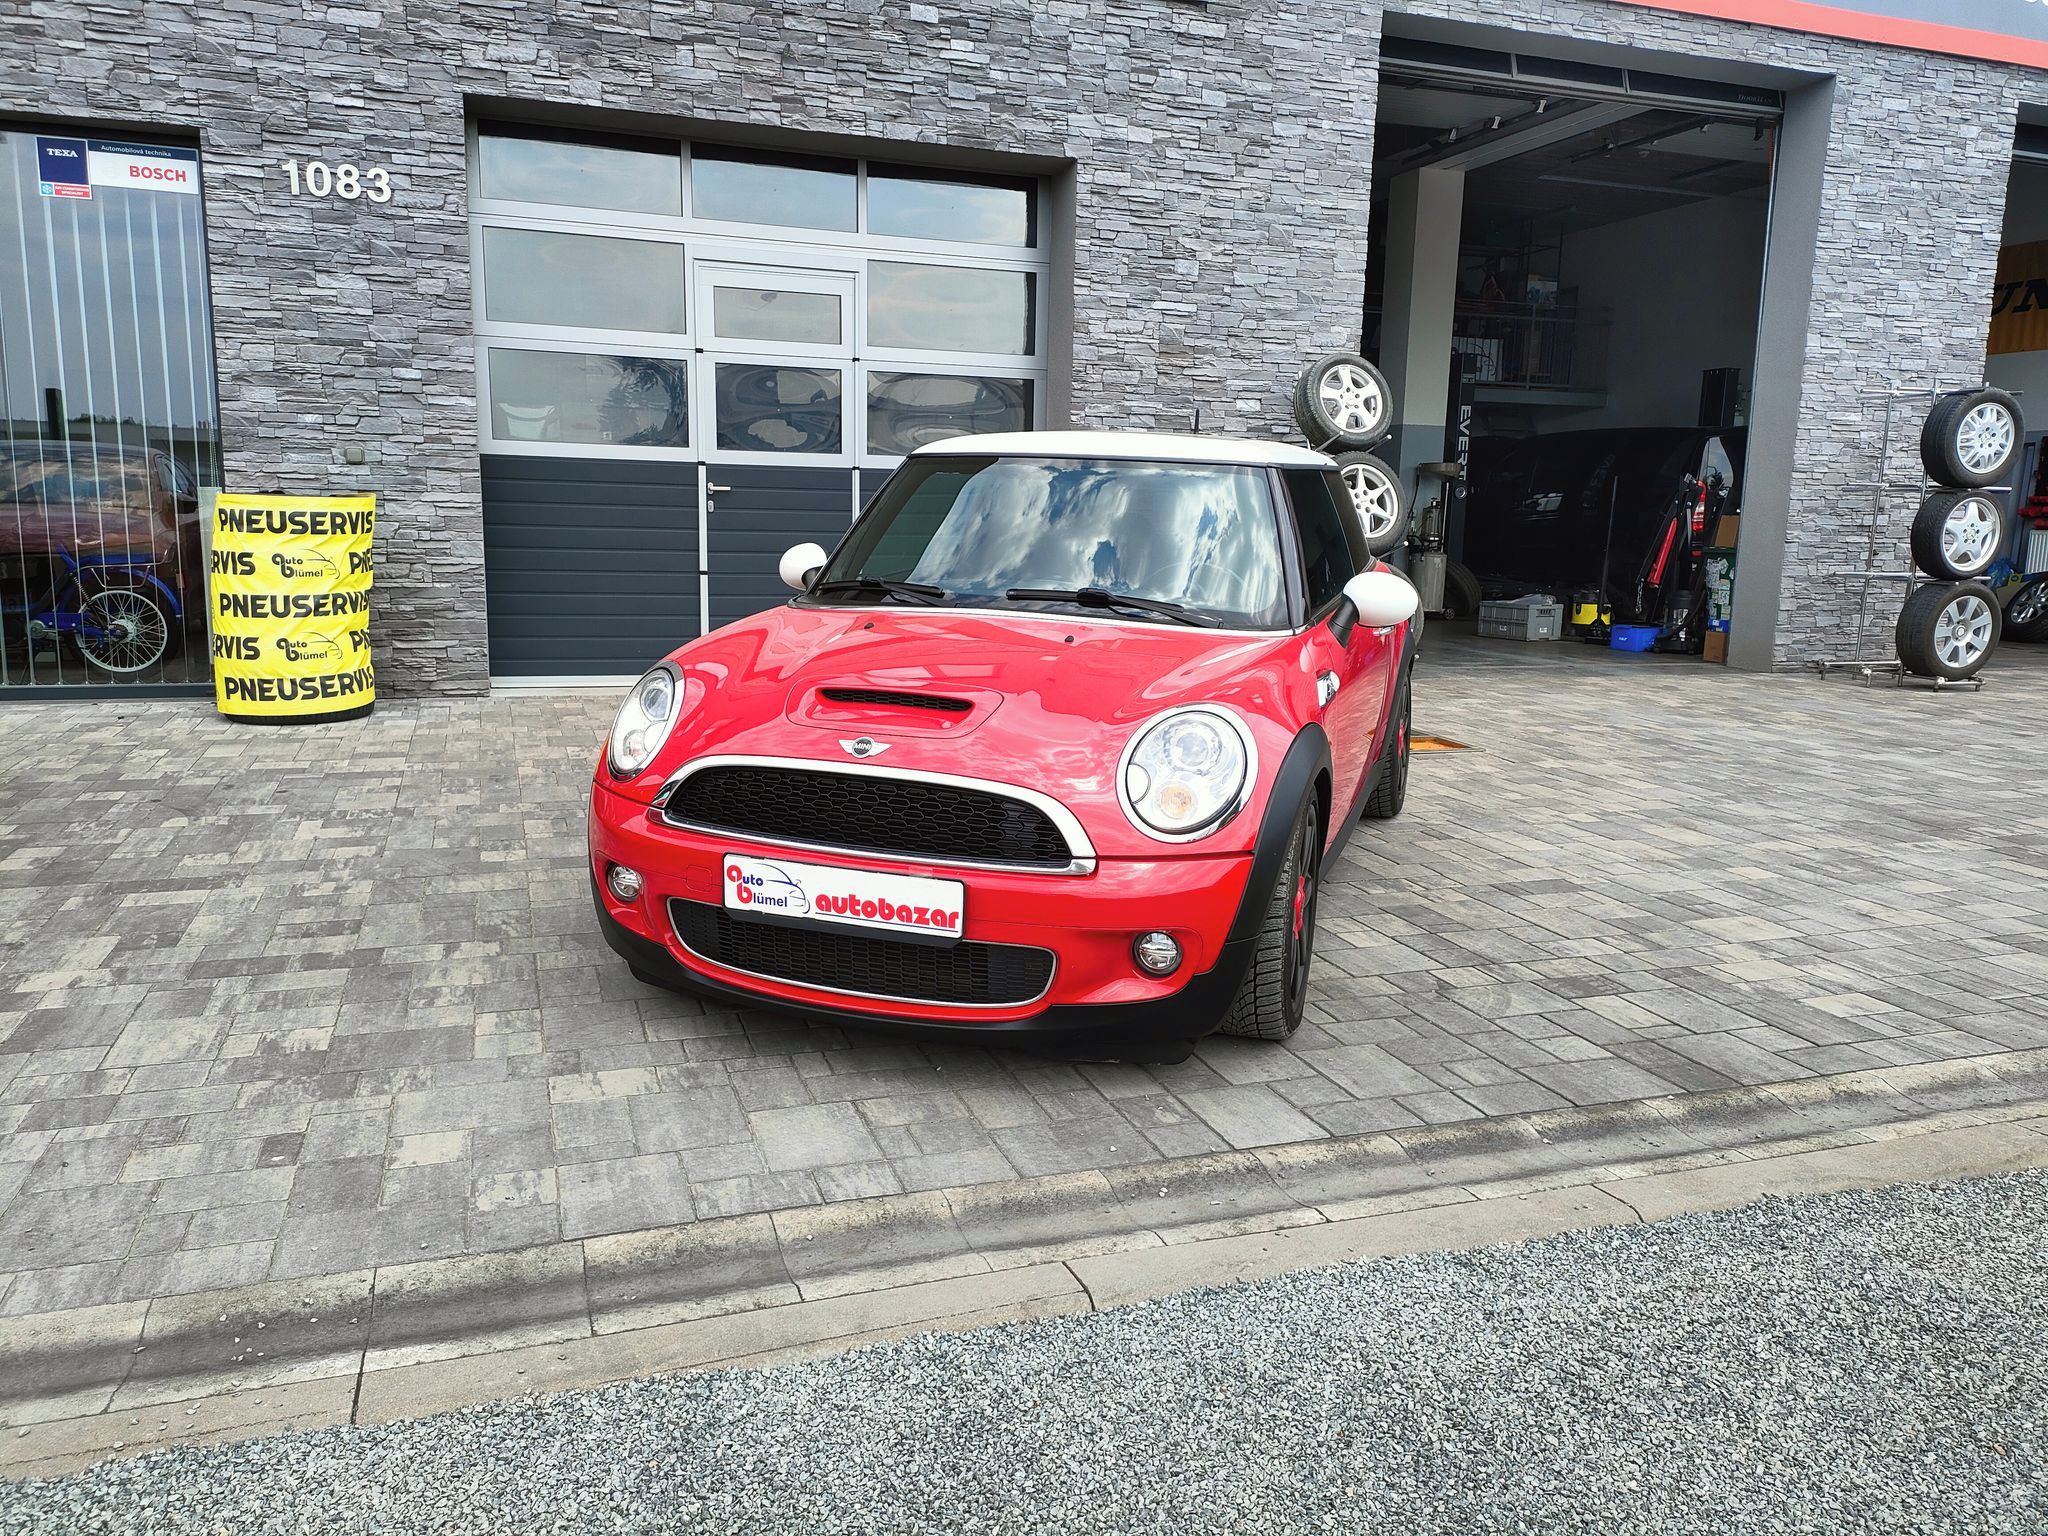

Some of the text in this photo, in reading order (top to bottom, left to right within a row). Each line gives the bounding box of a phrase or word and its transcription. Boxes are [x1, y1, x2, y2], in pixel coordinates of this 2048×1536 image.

[46, 148, 79, 158] TEXA
[101, 144, 172, 158] Automobilová technika
[129, 164, 187, 182] BOSCH
[281, 159, 392, 203] 1083
[1457, 405, 1472, 481] EVERT
[218, 508, 373, 536] PNEUSERVIS
[219, 589, 370, 619] PNEUSERVIS
[224, 665, 374, 702] PNEUSERVIS
[854, 743, 872, 751] MINI
[736, 881, 959, 929] blümel autobazar
